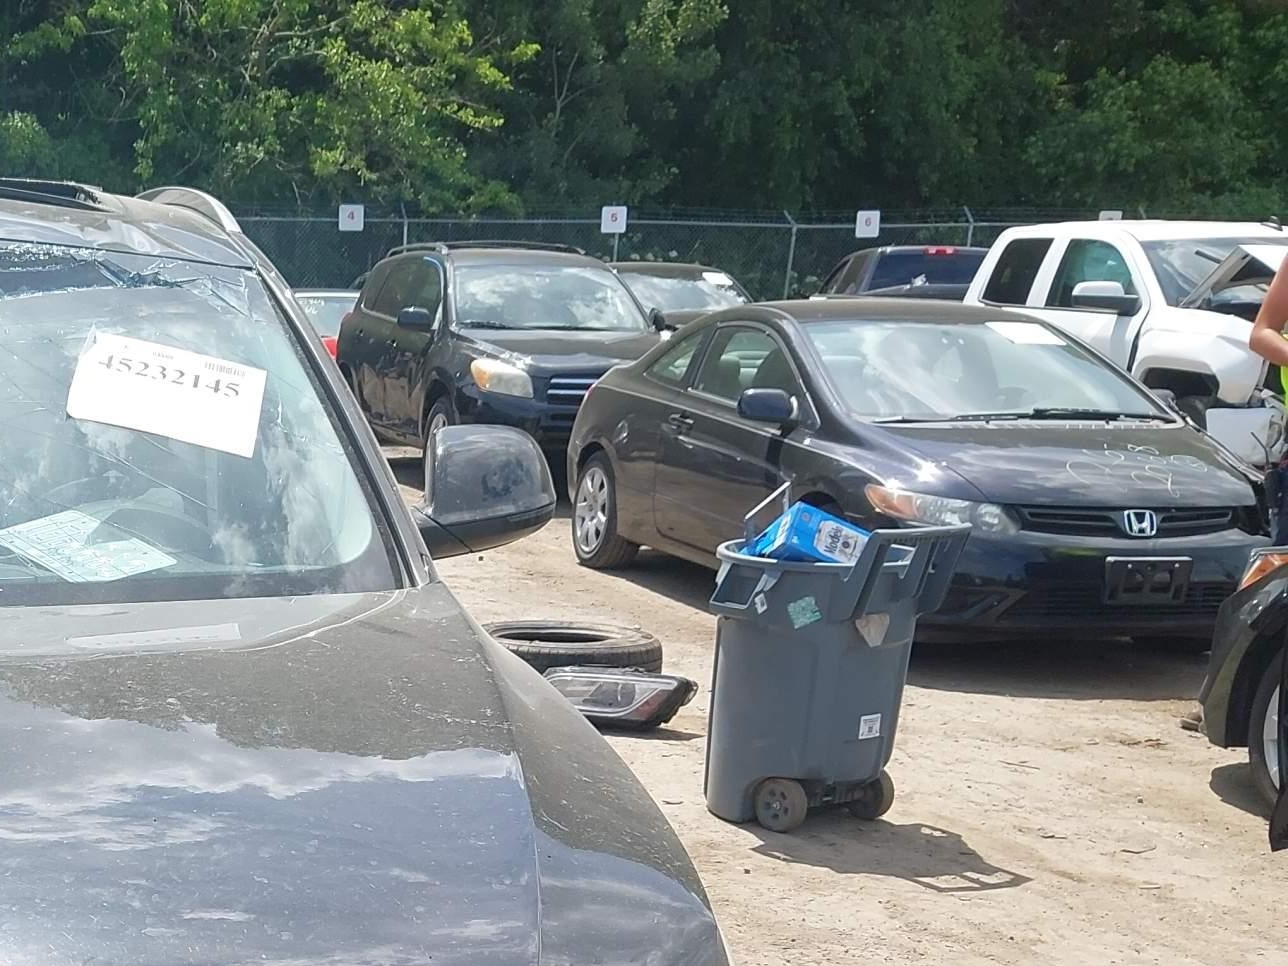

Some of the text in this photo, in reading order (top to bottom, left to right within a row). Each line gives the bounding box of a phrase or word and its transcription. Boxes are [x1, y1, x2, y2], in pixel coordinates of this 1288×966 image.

[346, 210, 355, 221] 4
[864, 216, 872, 227] 6
[97, 354, 241, 398] 45232145
